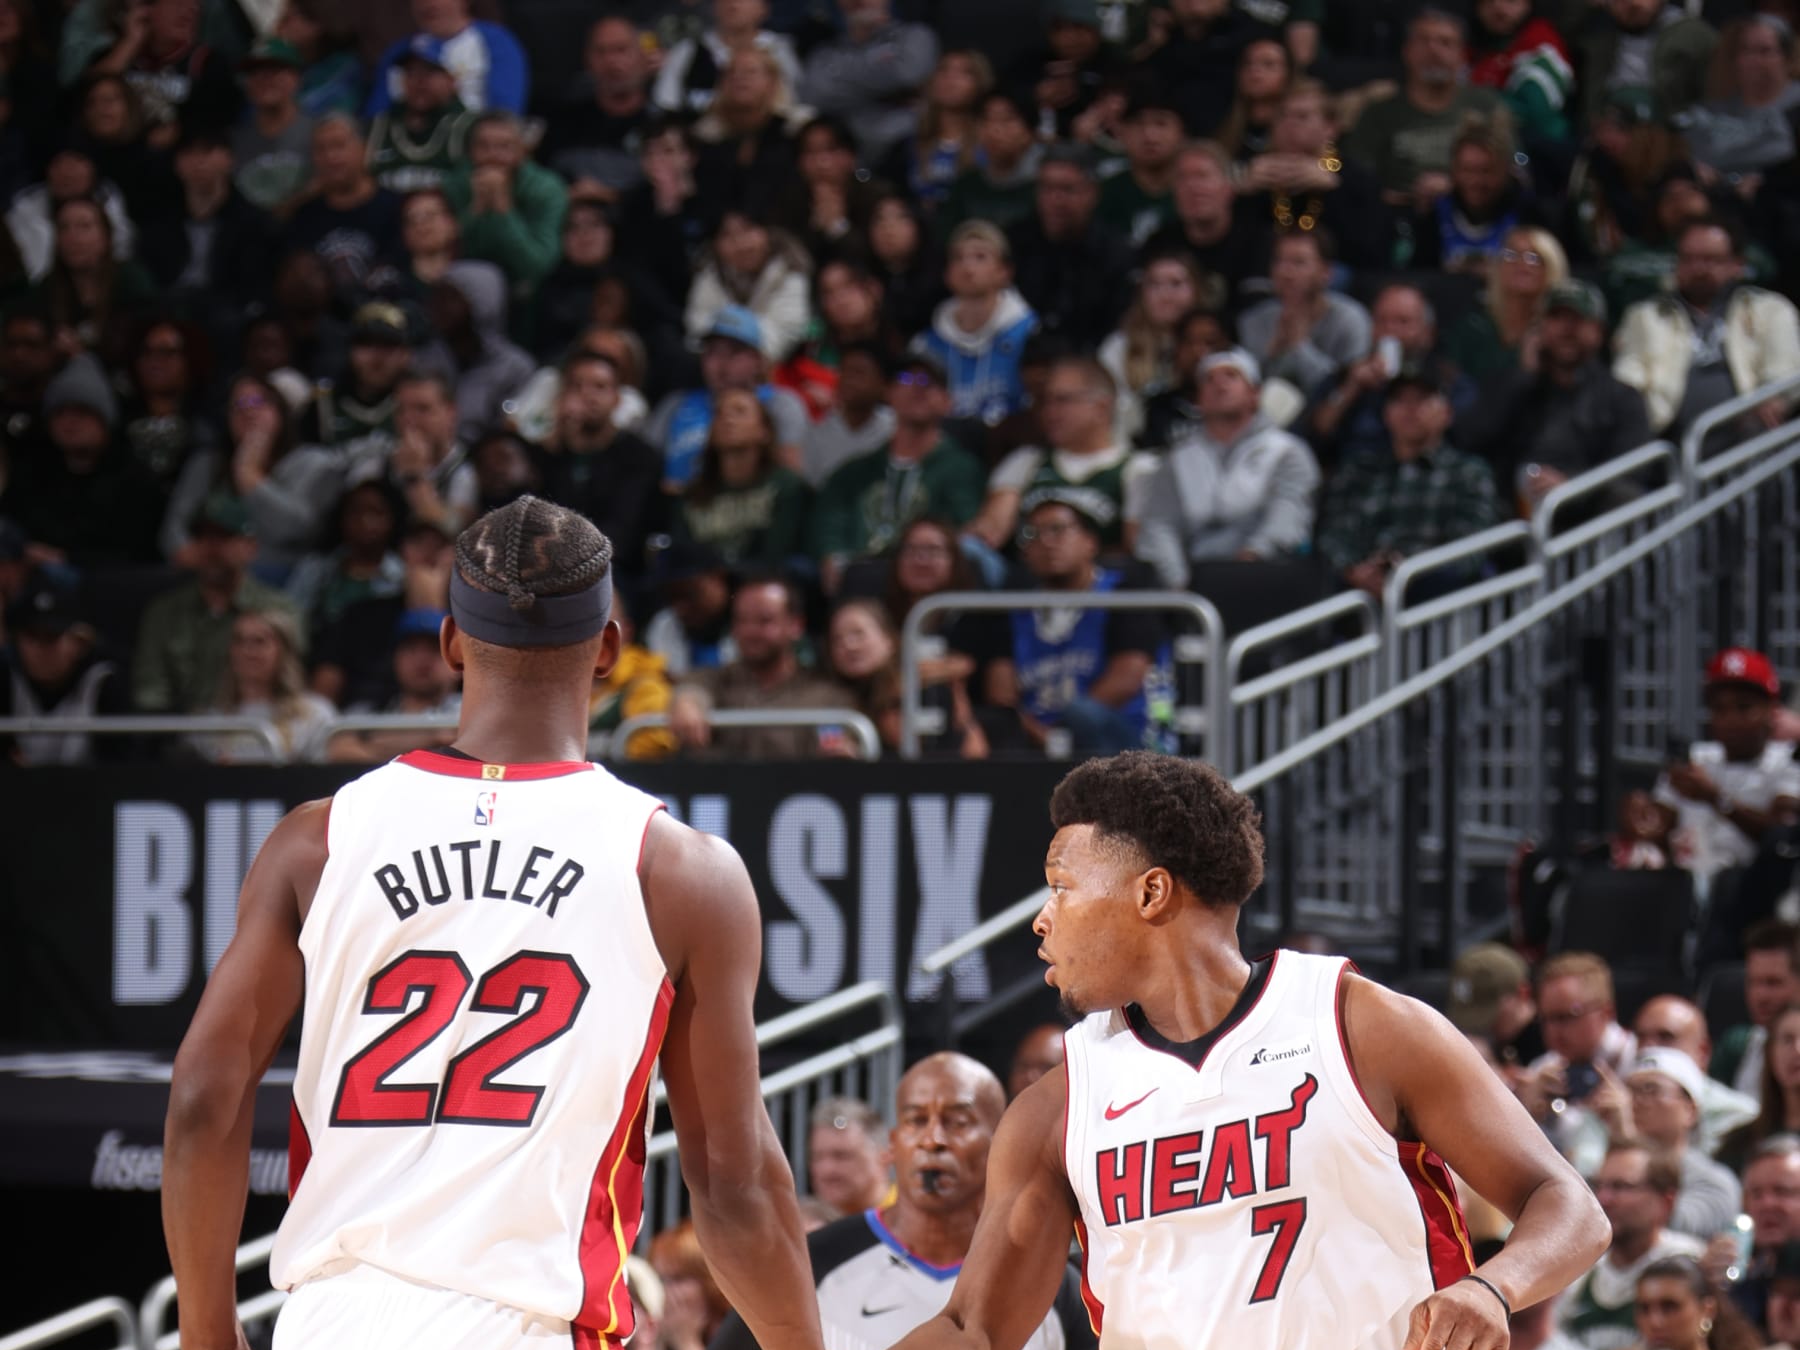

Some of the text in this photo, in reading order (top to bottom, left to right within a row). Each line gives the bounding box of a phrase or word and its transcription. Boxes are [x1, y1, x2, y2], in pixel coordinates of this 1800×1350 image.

[373, 839, 585, 922] BUTLER
[766, 792, 993, 1003] SIX
[328, 949, 591, 1128] 22
[1262, 1043, 1311, 1063] Carnival
[1096, 1071, 1319, 1227] HEAT
[1248, 1196, 1308, 1305] 7
